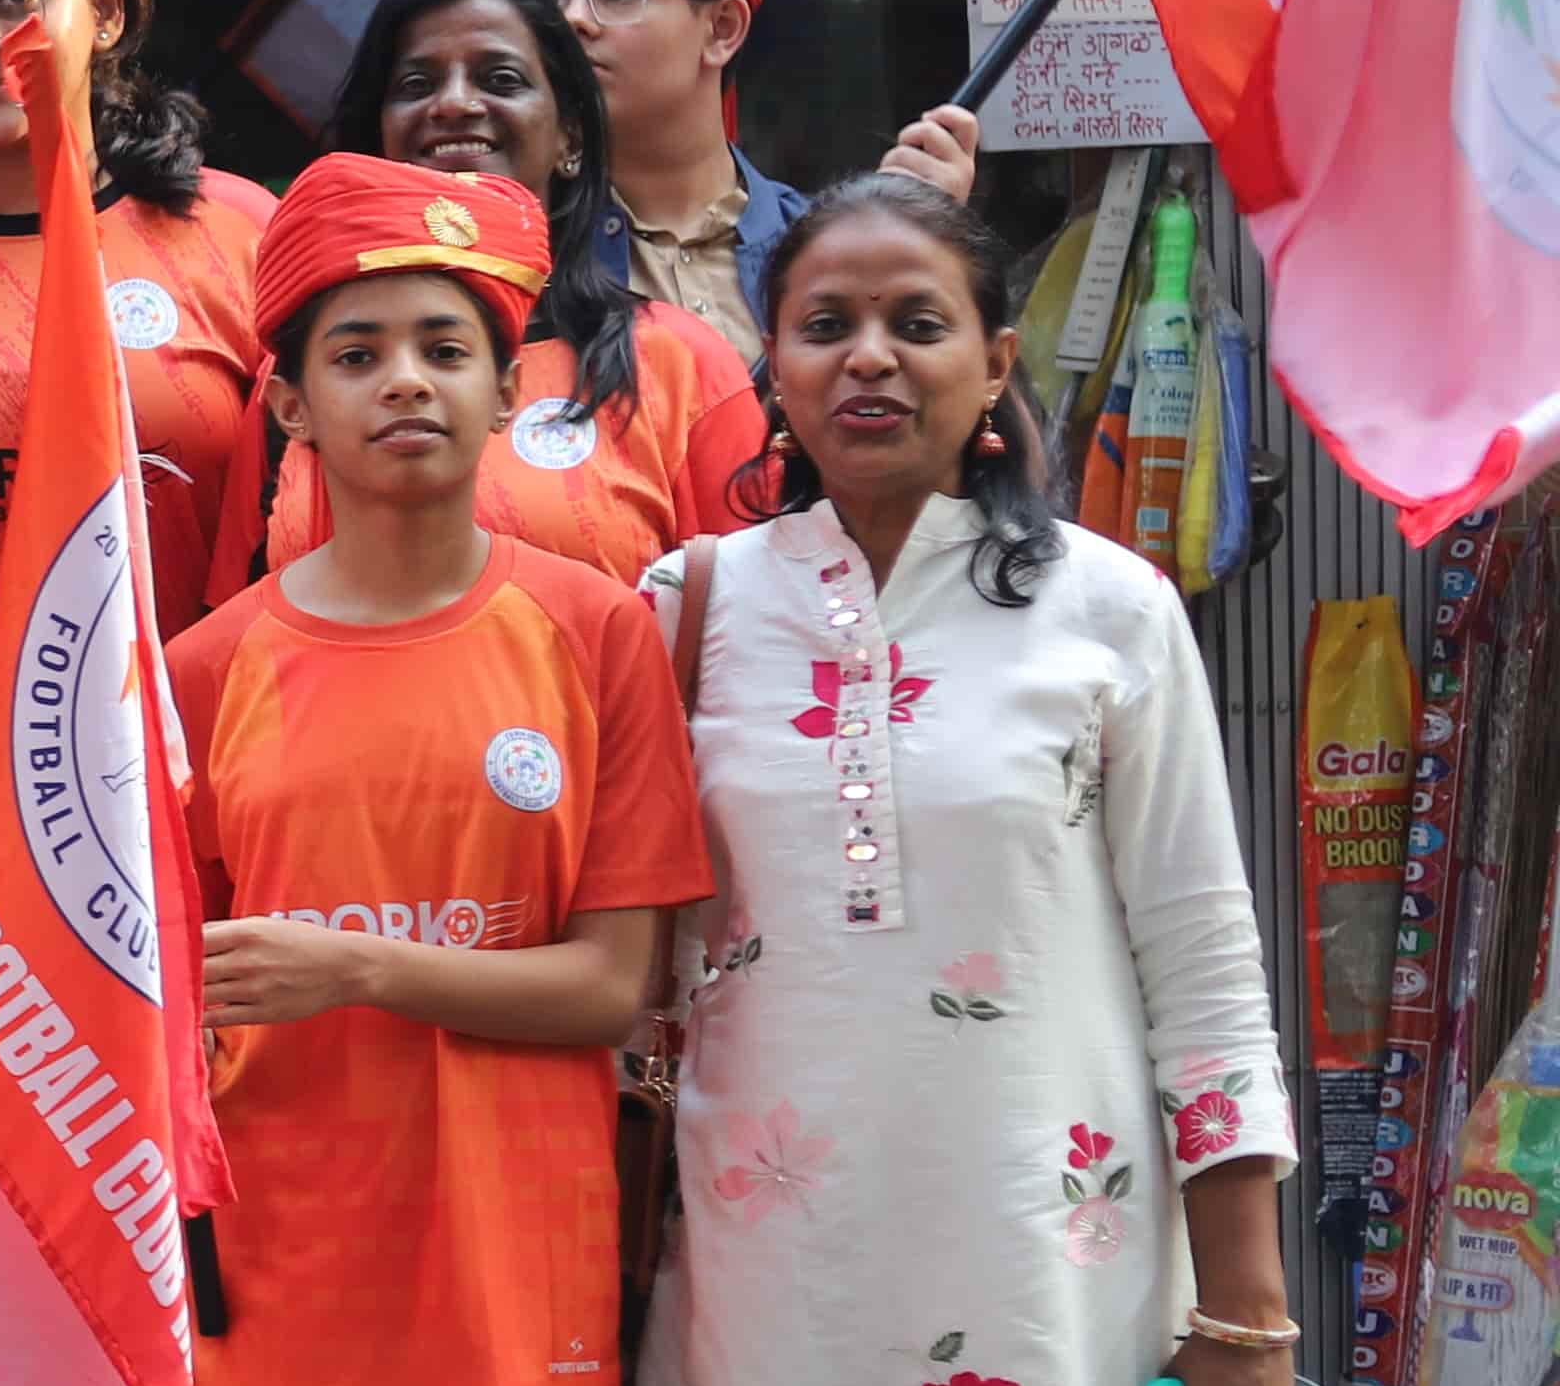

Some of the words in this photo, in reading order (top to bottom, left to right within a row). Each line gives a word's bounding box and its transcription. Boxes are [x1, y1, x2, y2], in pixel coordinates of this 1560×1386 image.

[93, 523, 119, 558] 20
[26, 612, 85, 866] FOOTBALL
[1316, 739, 1409, 777] Gala
[1314, 805, 1350, 834] NO
[1358, 804, 1405, 833] DUS
[1452, 1183, 1531, 1214] nova
[1458, 1234, 1486, 1250] WET
[1479, 1282, 1504, 1302] FIT
